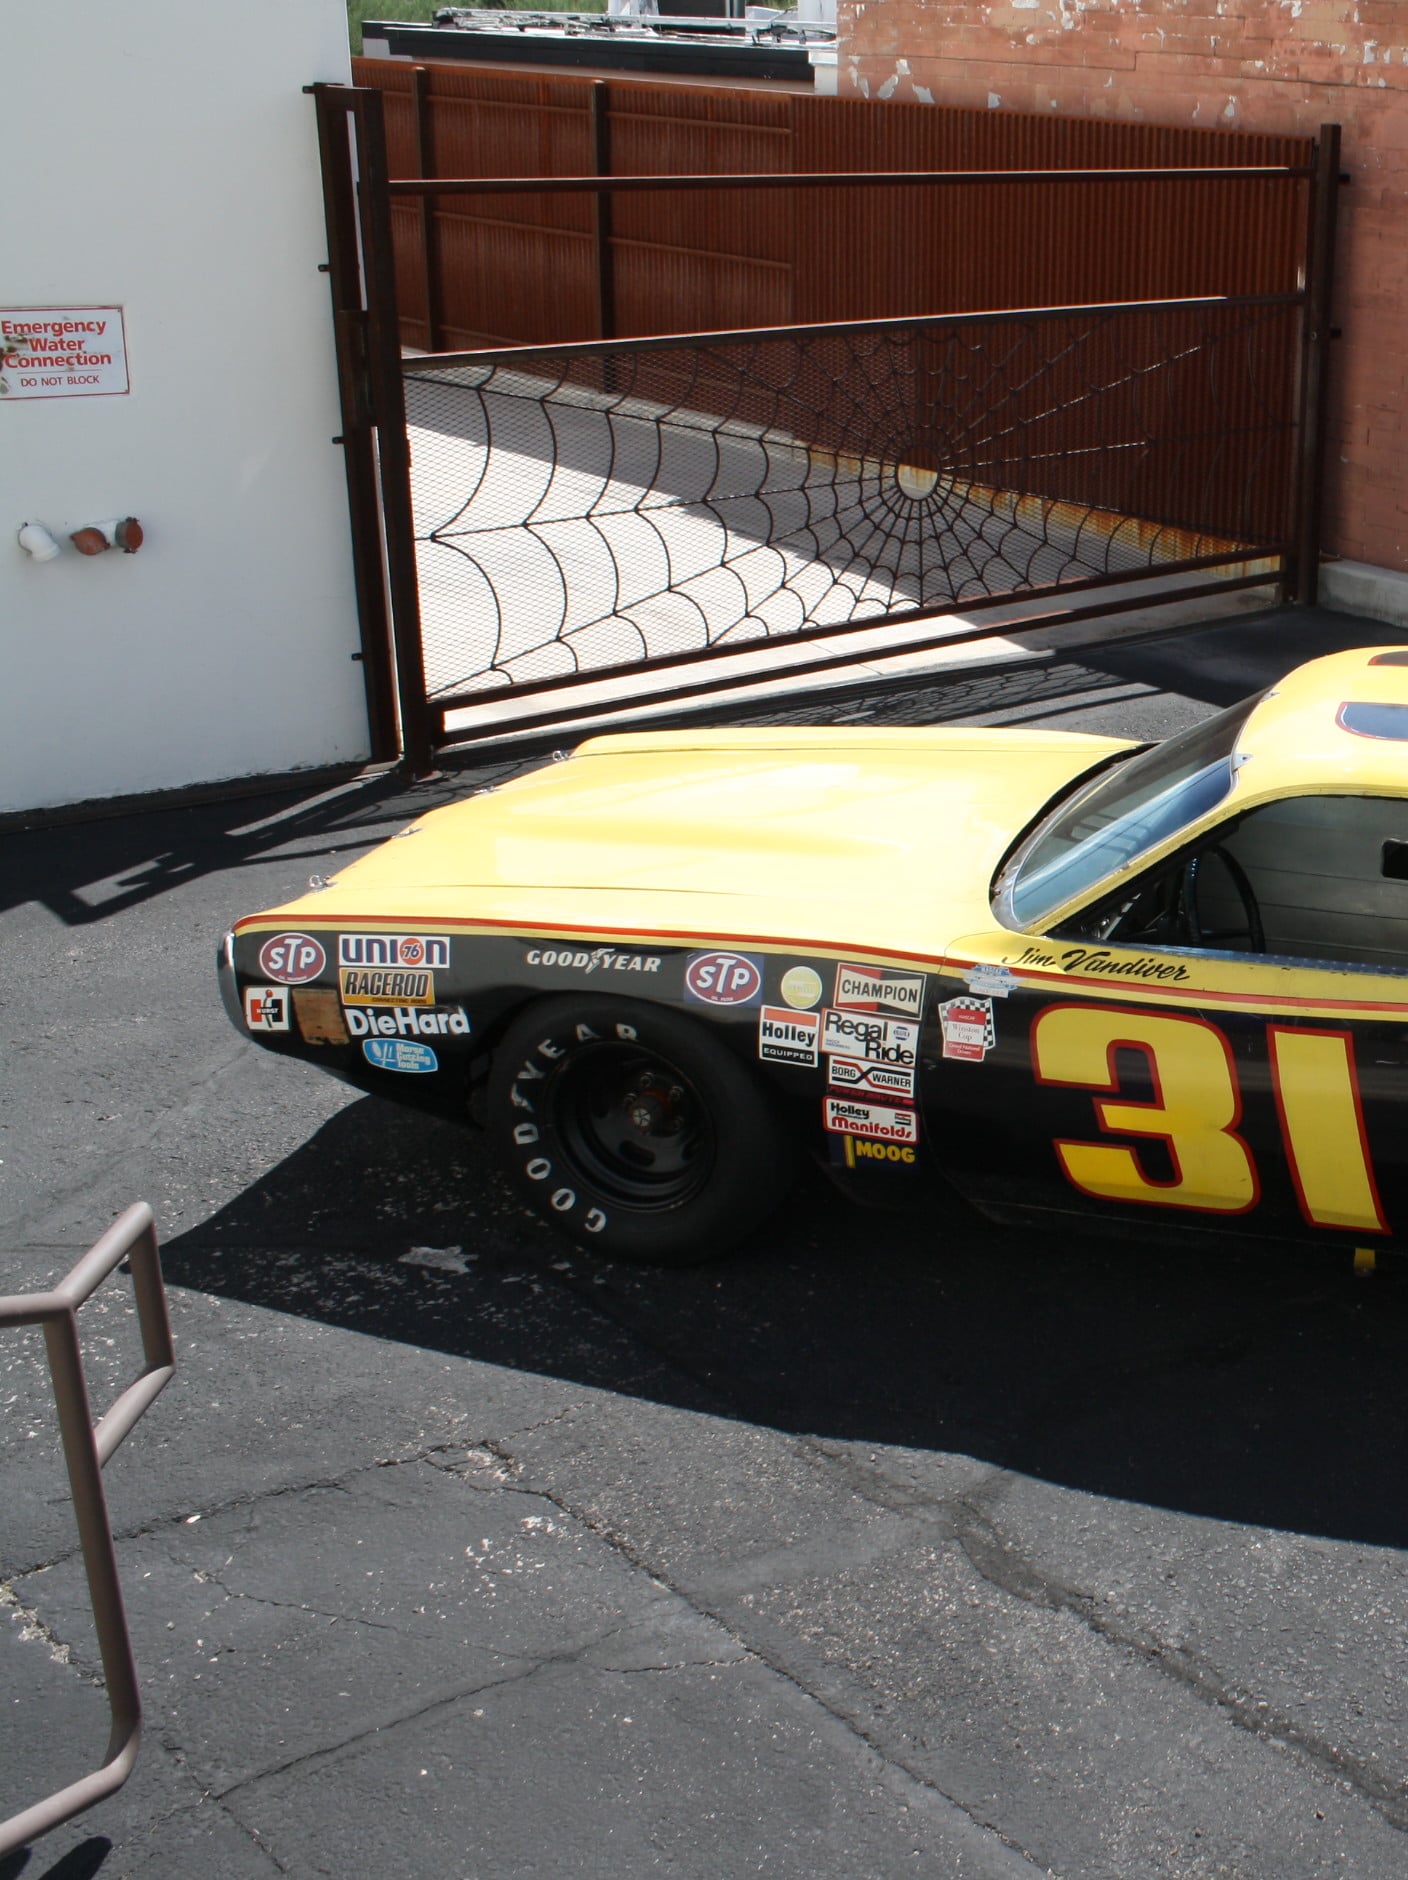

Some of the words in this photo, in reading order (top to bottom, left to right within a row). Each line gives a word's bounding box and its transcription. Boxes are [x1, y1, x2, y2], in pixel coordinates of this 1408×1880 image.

[1, 320, 106, 337] Emergency
[28, 337, 85, 352] Water
[5, 351, 112, 368] Connection
[21, 378, 37, 387] DO
[41, 377, 63, 386] NOT
[67, 375, 100, 385] BLOCK
[268, 938, 316, 974] STP
[1001, 947, 1057, 967] Jim
[1061, 949, 1191, 982] Vandiver
[345, 971, 429, 998] RACEROD
[695, 958, 750, 994] STP
[842, 979, 919, 1003] CHAMPION
[344, 1006, 471, 1035] DieHard
[825, 1011, 889, 1043] Regal
[762, 1020, 816, 1047] Holley
[763, 1048, 813, 1062] EQUIPPED
[864, 1041, 915, 1066] Ride
[831, 1065, 856, 1079] BORG
[872, 1072, 911, 1088] WARNER
[830, 1101, 869, 1120] Holley
[1030, 1001, 1392, 1235] 31
[831, 1116, 912, 1139] Manifolds
[855, 1140, 916, 1163] MOOG
